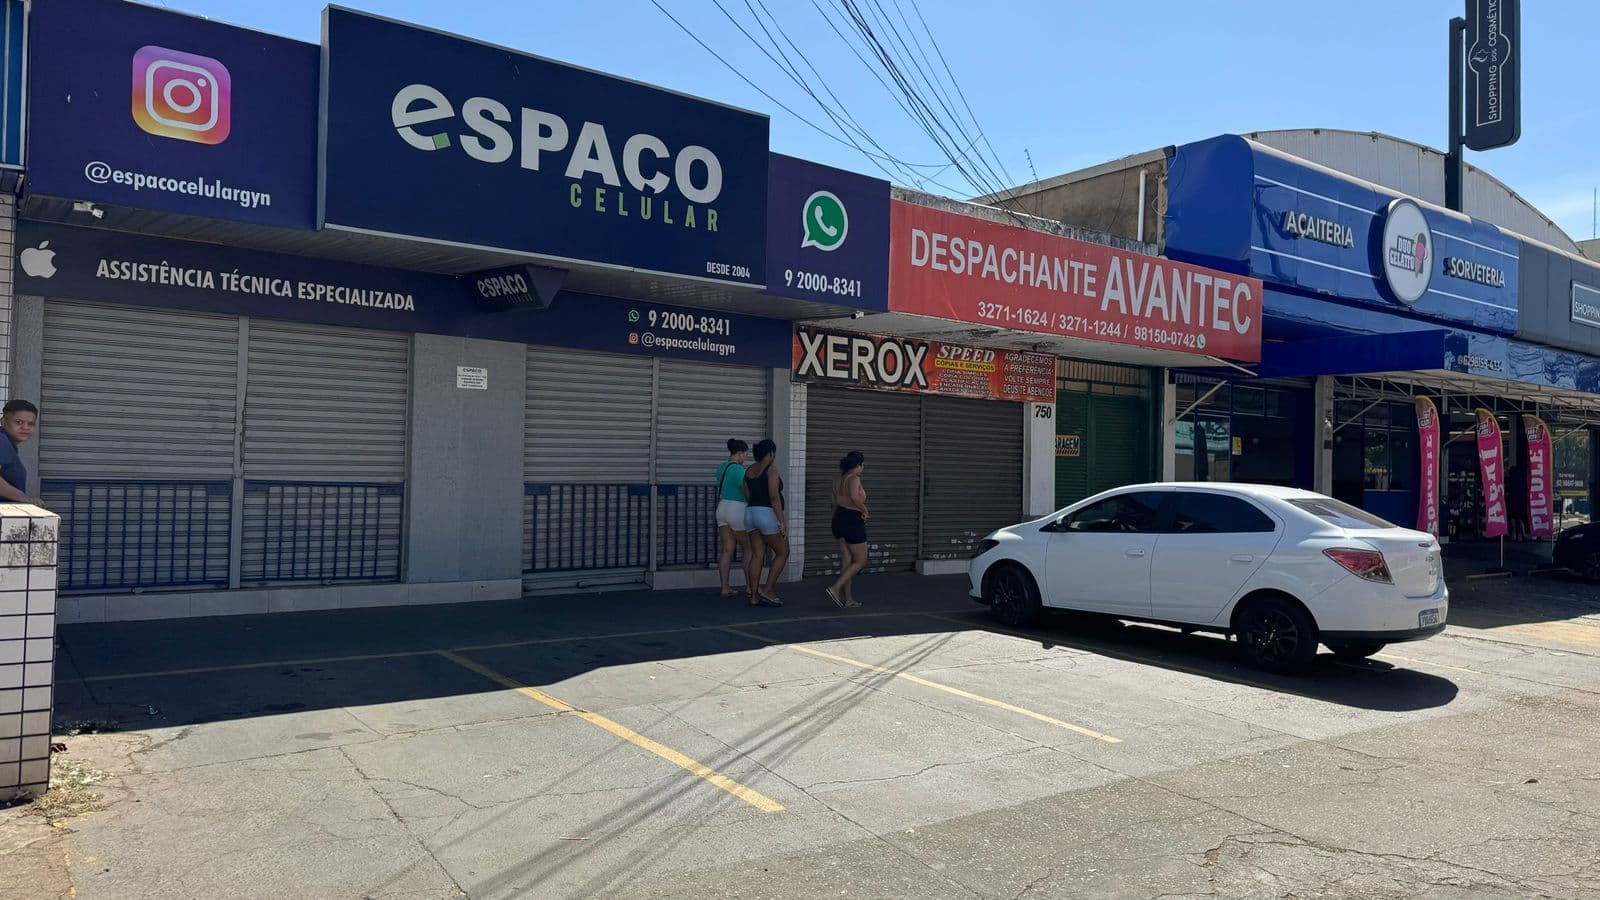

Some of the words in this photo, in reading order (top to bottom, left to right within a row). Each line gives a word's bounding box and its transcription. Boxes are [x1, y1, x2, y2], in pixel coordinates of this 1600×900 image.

[1486, 0, 1497, 47] COSMÉTIC
[1488, 65, 1497, 120] SHOPPING
[85, 161, 271, 208] @espacocelulargyn
[570, 183, 718, 231] CELULAR
[1285, 210, 1354, 248] AÇAITERIA
[96, 259, 215, 289] ASSISTÊNCIA
[220, 268, 292, 298] TÉCNICA
[298, 281, 415, 312] ESPECIALIZADA
[706, 261, 730, 276] DESDE
[731, 265, 751, 278] 2004
[785, 269, 793, 287] 9
[797, 271, 861, 297] 2000-8341
[911, 228, 1097, 298] DESPACHANTE
[1101, 256, 1252, 335] AVANTEC
[1450, 256, 1505, 288] SORVETERIA
[648, 310, 657, 327] 9
[661, 311, 730, 336] 2000-8341
[978, 301, 1048, 326] 3271-1624
[1051, 312, 1056, 328] /
[1059, 314, 1121, 337] 3271-1244
[1134, 326, 1197, 348] 98150-0742
[1575, 301, 1600, 318] SHOPPIN
[641, 332, 735, 356] @espacocelulargyn
[798, 332, 927, 386] XEROX
[937, 345, 995, 362] SPEED
[1035, 405, 1052, 419] 750
[1055, 437, 1079, 449] ARAGEM
